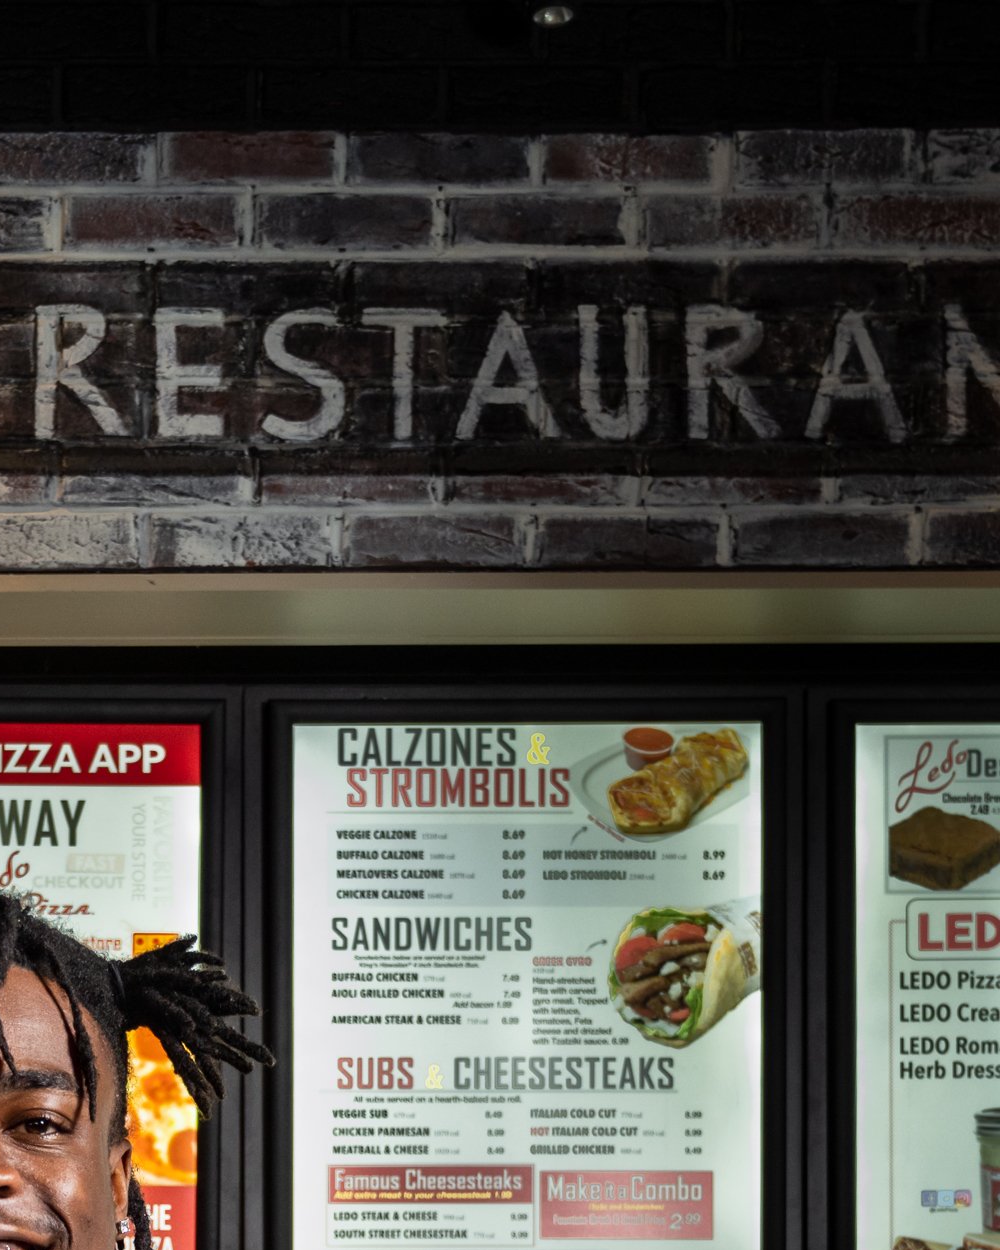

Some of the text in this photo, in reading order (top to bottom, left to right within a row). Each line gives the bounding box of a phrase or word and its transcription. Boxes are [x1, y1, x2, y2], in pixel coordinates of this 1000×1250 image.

[337, 727, 552, 767] CALZONES &
[88, 743, 167, 774] APP
[895, 739, 968, 813] Ledo
[346, 767, 571, 808] STROMBOLIS
[336, 830, 526, 840] VEGGIE CALZONE 8.69
[336, 850, 425, 860] BUFFALO CALZONE
[702, 851, 726, 860] 8.99
[32, 875, 126, 889] CHECKOUT
[331, 916, 533, 952] SANDWICHES
[331, 972, 419, 982] BUFFALO CHICKEN
[899, 971, 951, 990] LEDO
[899, 1003, 951, 1023] LEDO
[336, 1056, 675, 1091] SUBS & CHEESESTEAKS
[900, 1060, 946, 1080] Herb
[332, 1127, 430, 1137] CHICKEN PARMESAN
[334, 1168, 522, 1190] Famous Cheesesteaks
[546, 1175, 703, 1201] Make Combo
